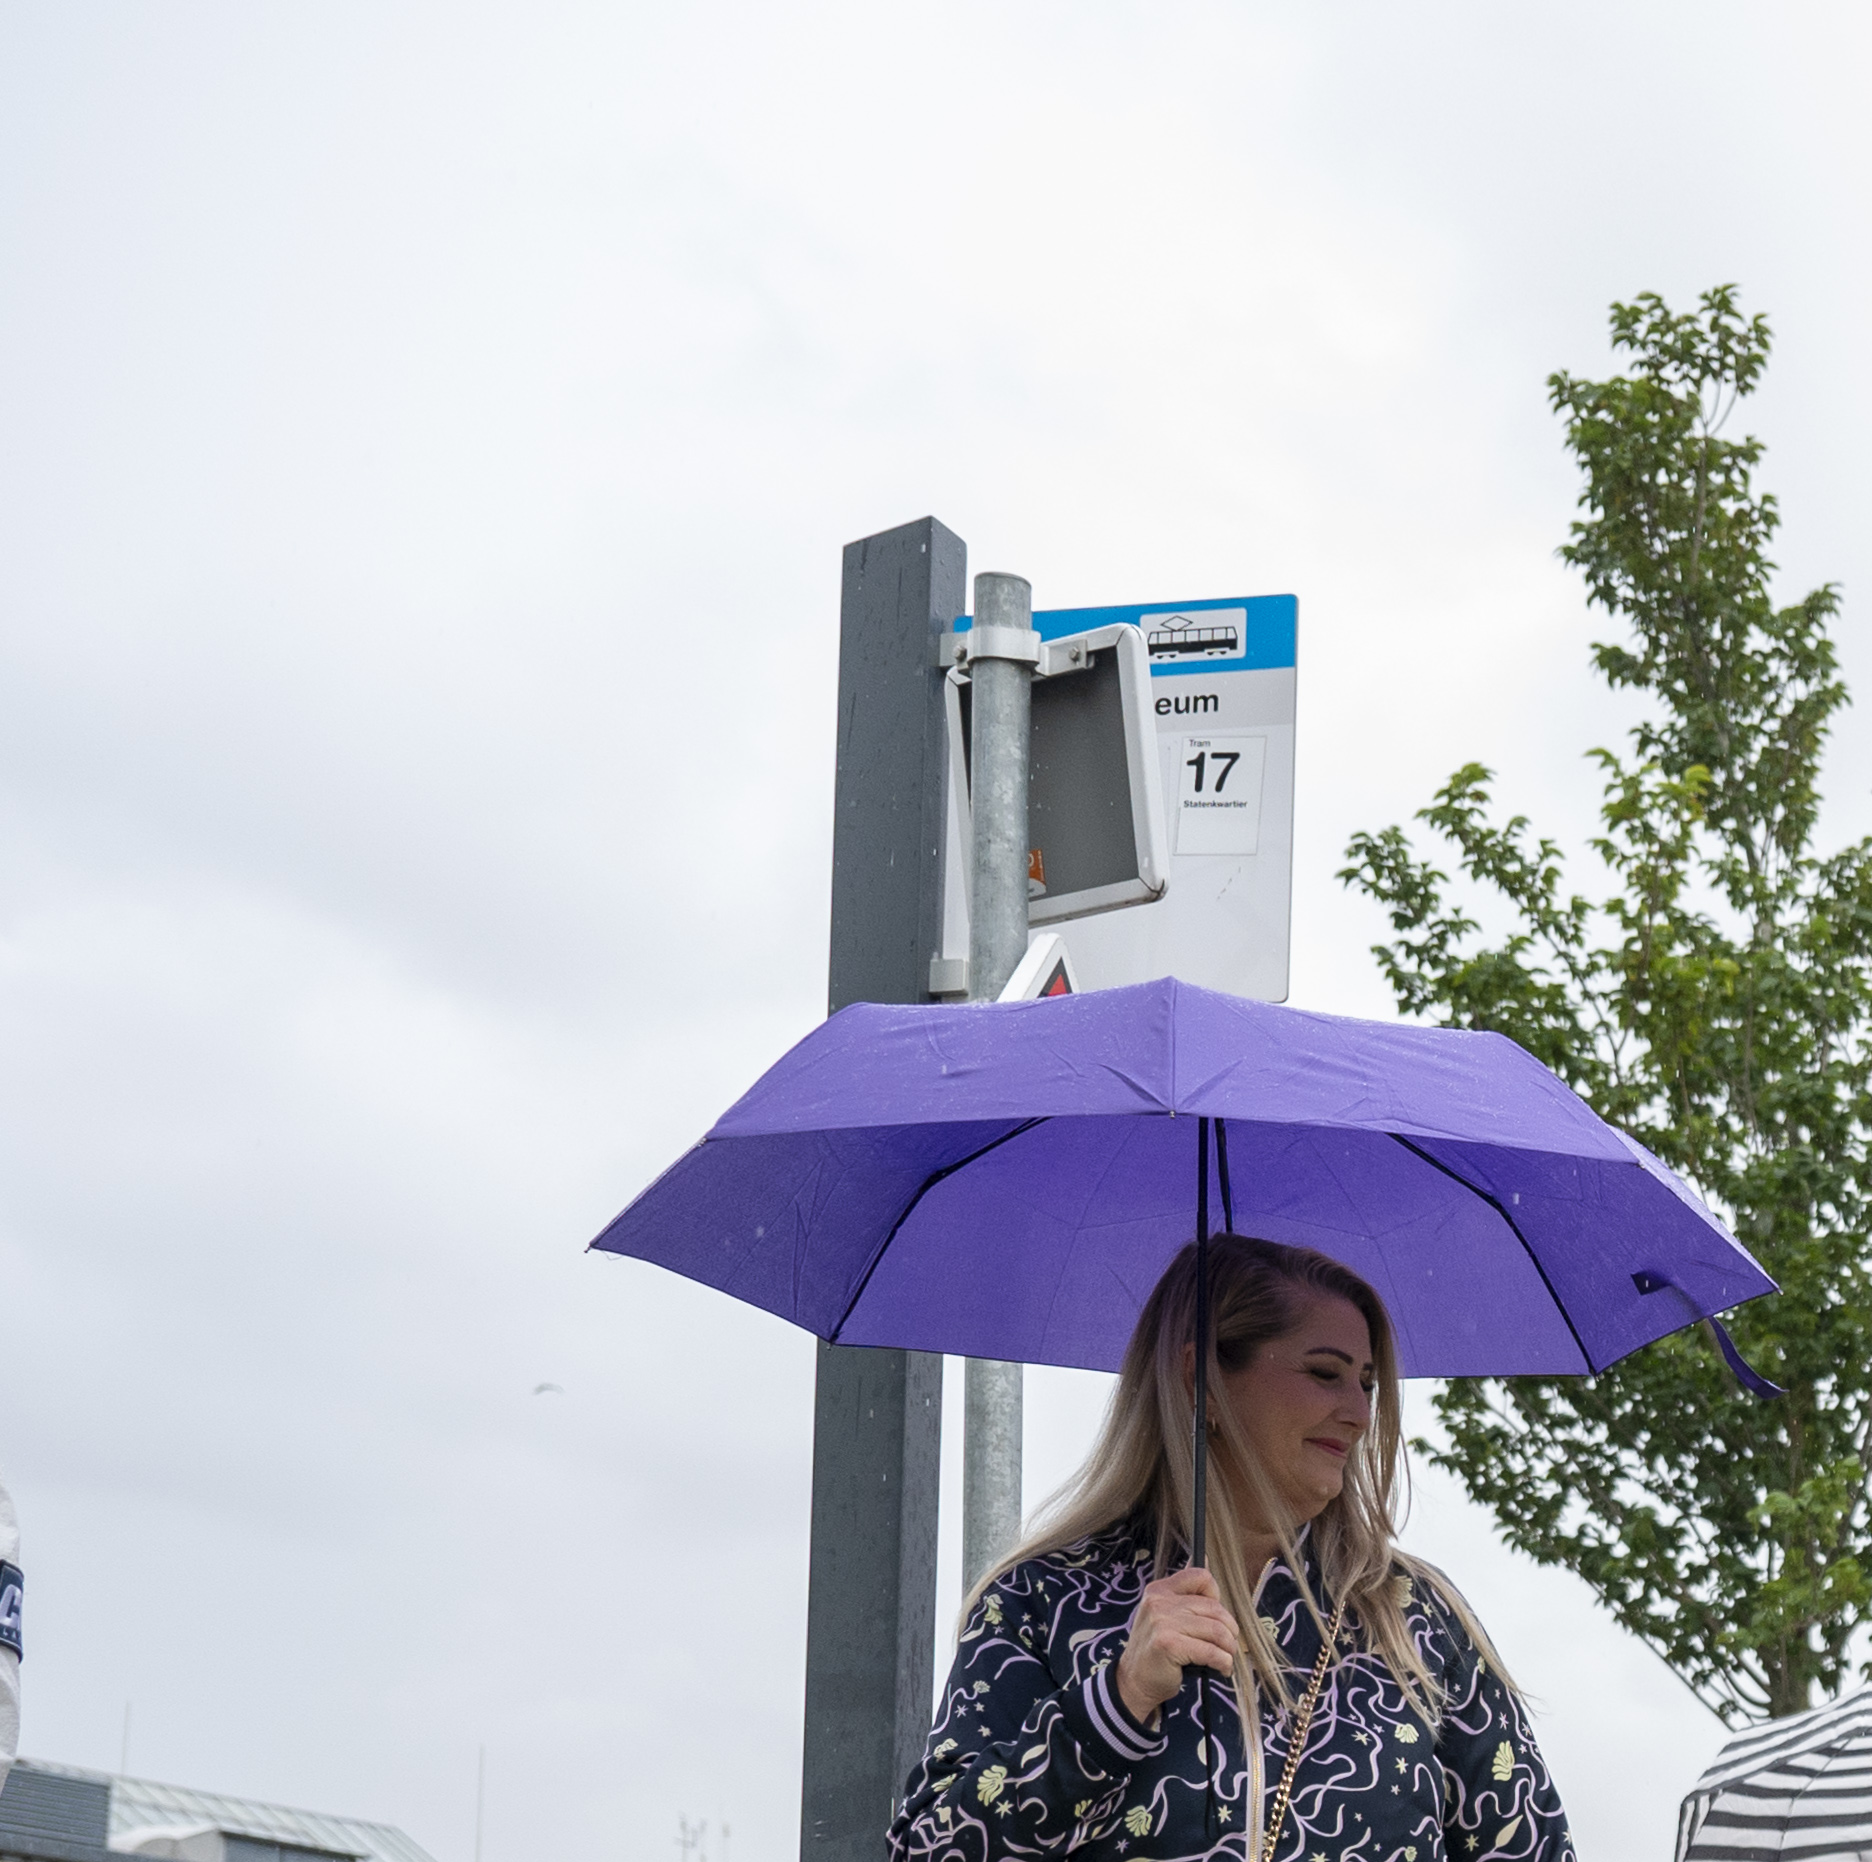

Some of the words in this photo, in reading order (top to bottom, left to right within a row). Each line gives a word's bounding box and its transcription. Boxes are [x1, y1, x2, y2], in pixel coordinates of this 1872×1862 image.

[1154, 693, 1220, 716] eum
[1189, 739, 1212, 748] Tram
[1186, 751, 1241, 793] 17
[1183, 799, 1249, 809] Statenkwartier
